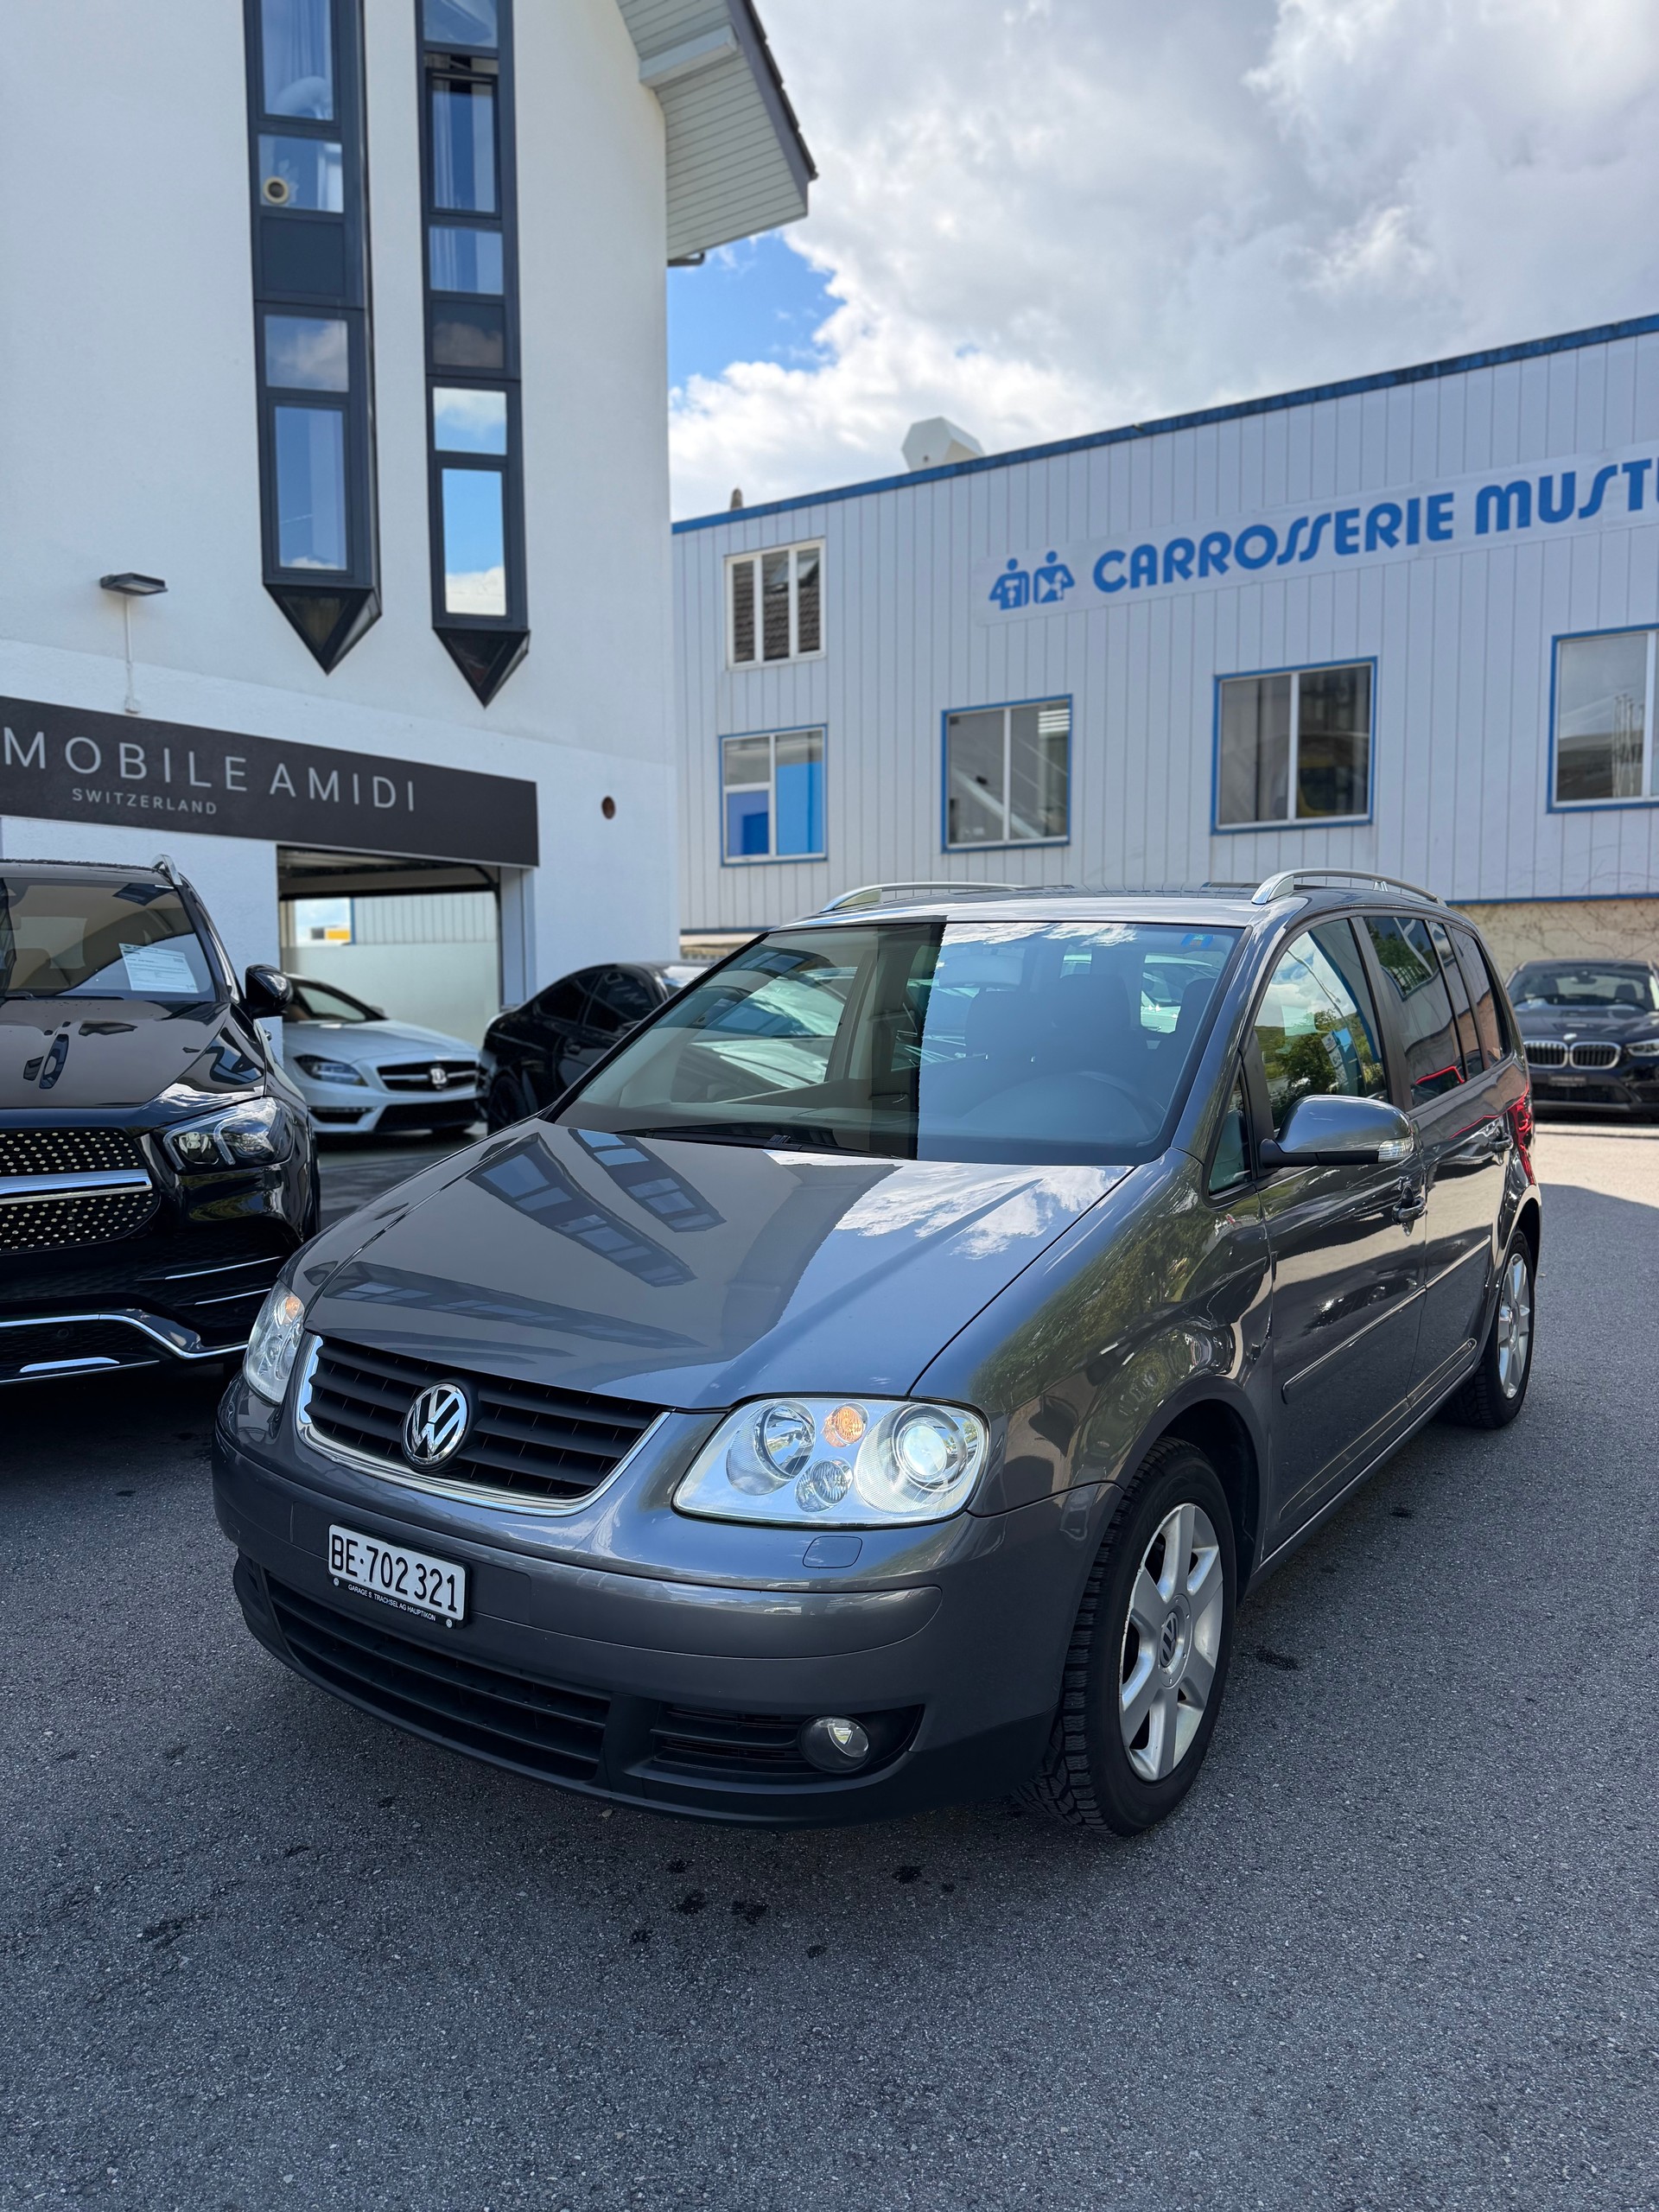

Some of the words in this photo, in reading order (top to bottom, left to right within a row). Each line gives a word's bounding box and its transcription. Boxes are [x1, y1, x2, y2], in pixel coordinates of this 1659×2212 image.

[1092, 492, 1455, 594] CARROSSERIE
[1474, 457, 1659, 536] MUST
[3, 727, 248, 792] MOBILE
[269, 762, 415, 812] AMIDI
[71, 787, 218, 816] SWITZERLAND
[347, 1584, 368, 1599] GARAGE
[373, 1593, 399, 1609] TRACHSEL
[398, 1603, 407, 1611] AG
